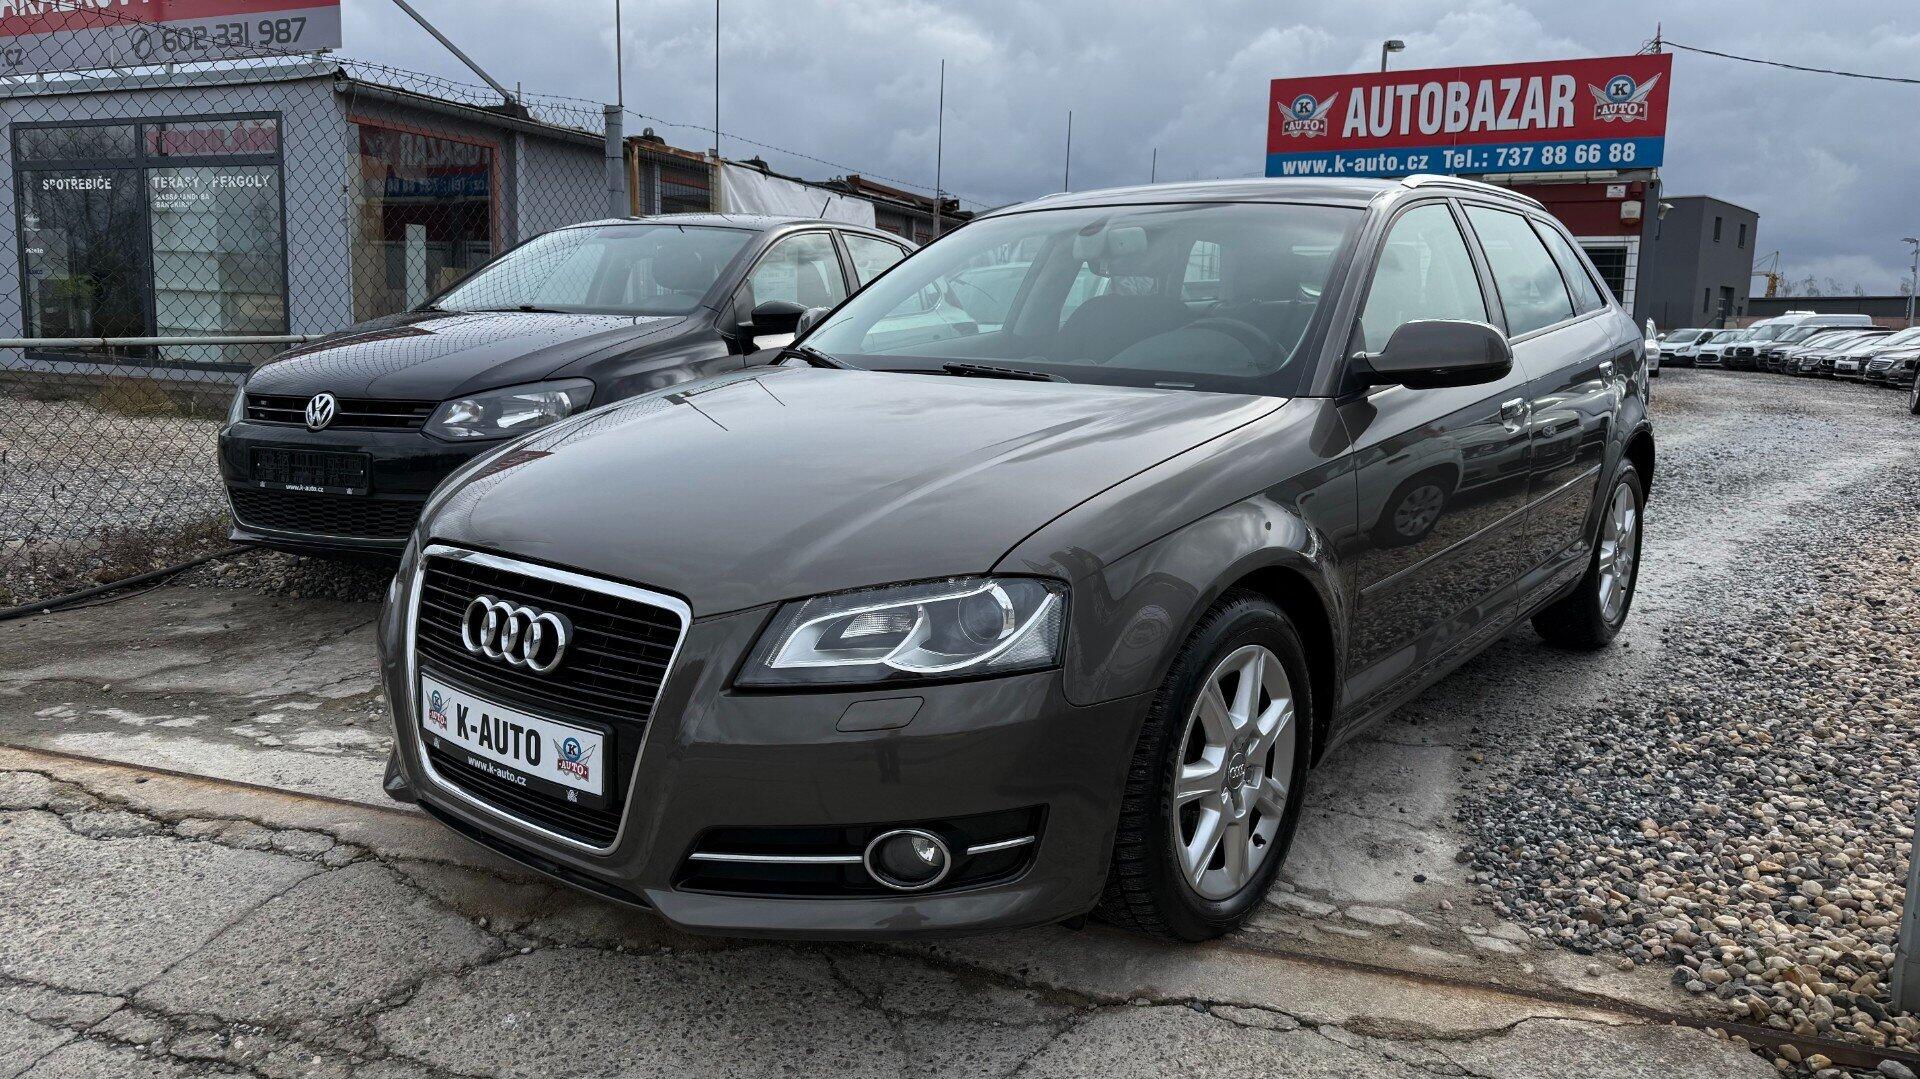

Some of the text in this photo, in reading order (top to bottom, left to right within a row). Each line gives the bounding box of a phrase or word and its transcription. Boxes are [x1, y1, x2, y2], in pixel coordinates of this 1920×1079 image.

[161, 16, 307, 52] 602 331 987
[1612, 83, 1629, 96] K
[1298, 101, 1312, 114] K
[1342, 74, 1576, 138] AUTOBAZAR
[1282, 142, 1636, 175] www.k-auto.cz Tel.: 737 88 66 88
[42, 175, 112, 190] SPOTŘEBIČE
[152, 175, 200, 189] TERASY
[212, 174, 271, 189] PERGOLY
[285, 483, 324, 493] www.k-auto.cz
[456, 702, 541, 767] K-AUTO
[567, 743, 577, 756] K
[467, 753, 527, 787] www.k-auto.cz
[561, 760, 585, 775] AUTO
